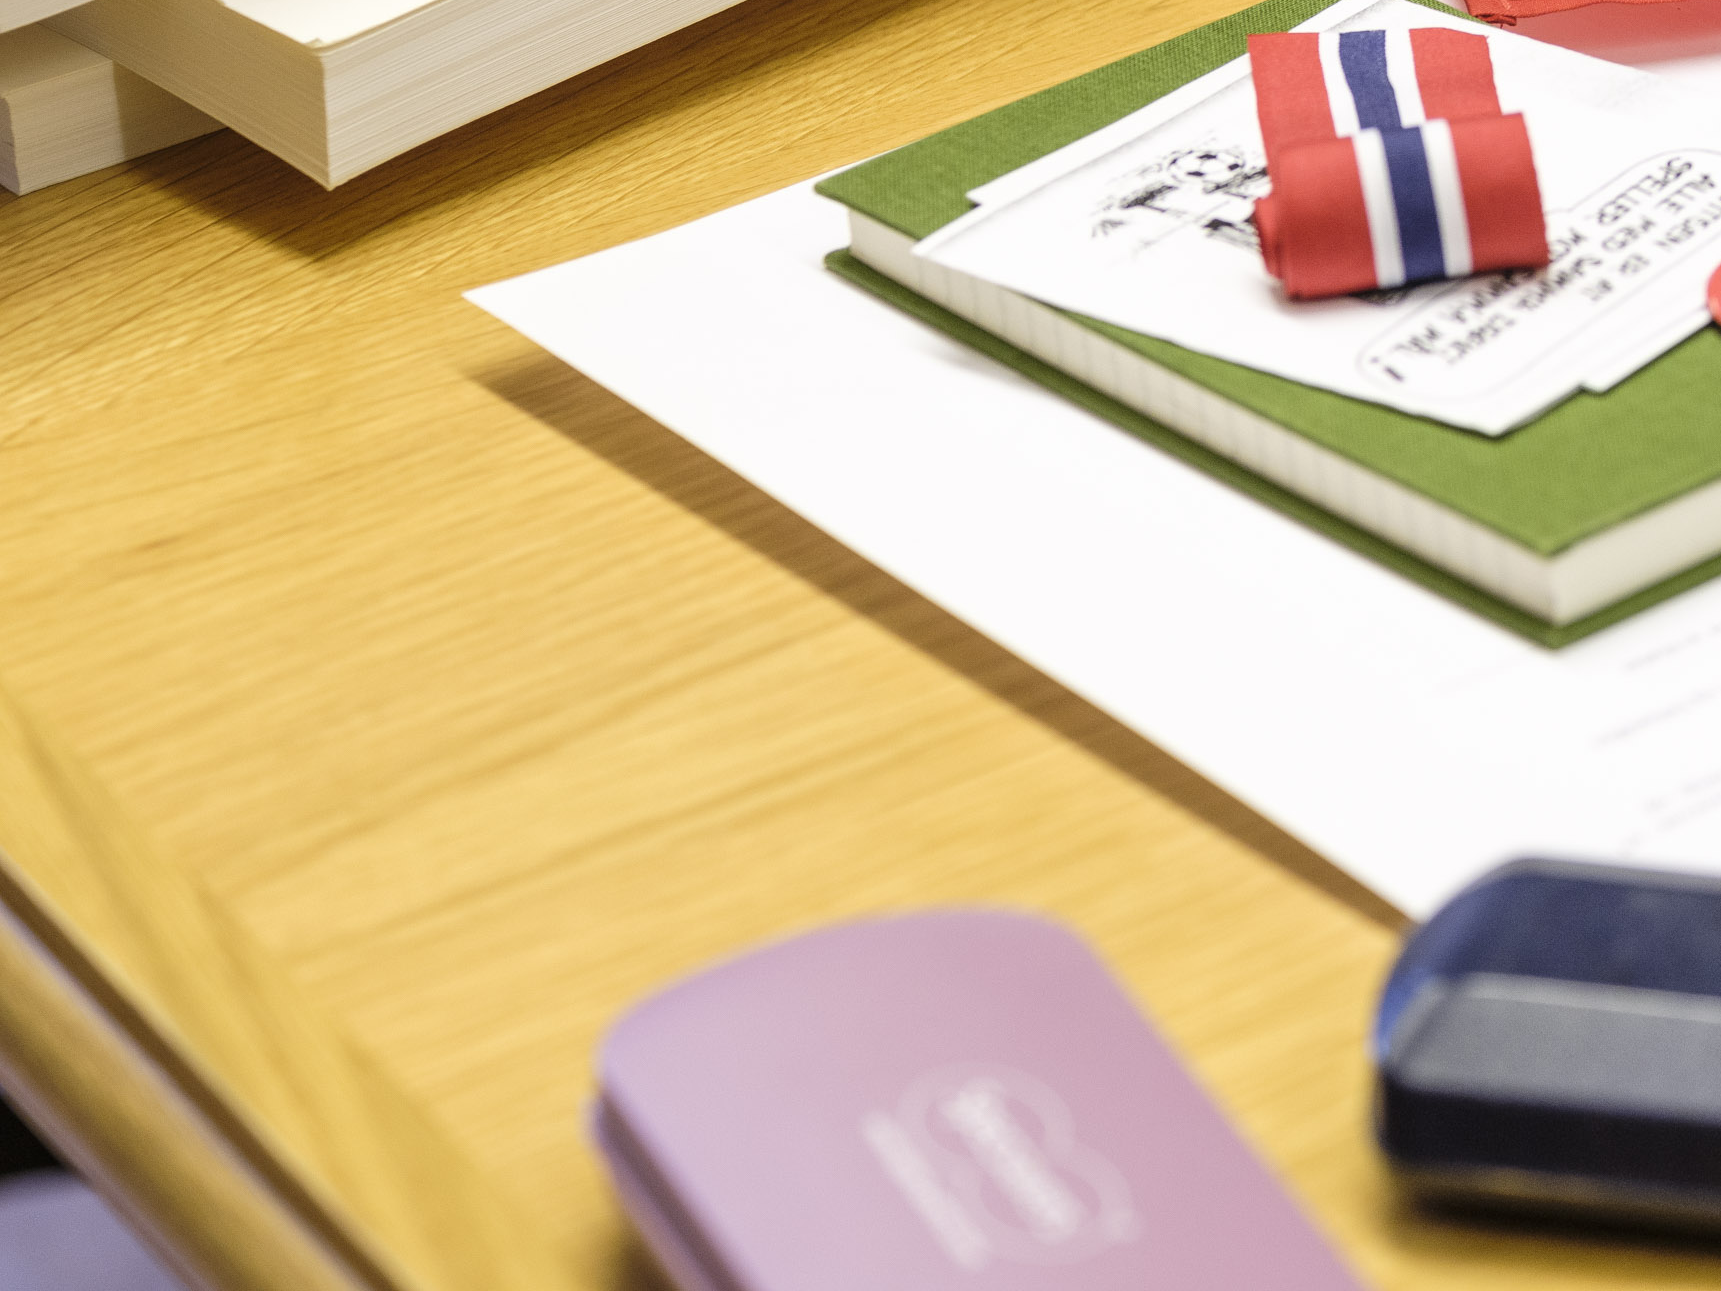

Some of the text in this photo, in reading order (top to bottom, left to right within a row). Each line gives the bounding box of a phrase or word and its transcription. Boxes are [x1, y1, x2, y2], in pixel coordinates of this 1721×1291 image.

[1597, 155, 1694, 227] SPELLER
[1654, 171, 1717, 217] ALLE
[1600, 214, 1655, 255] MED
